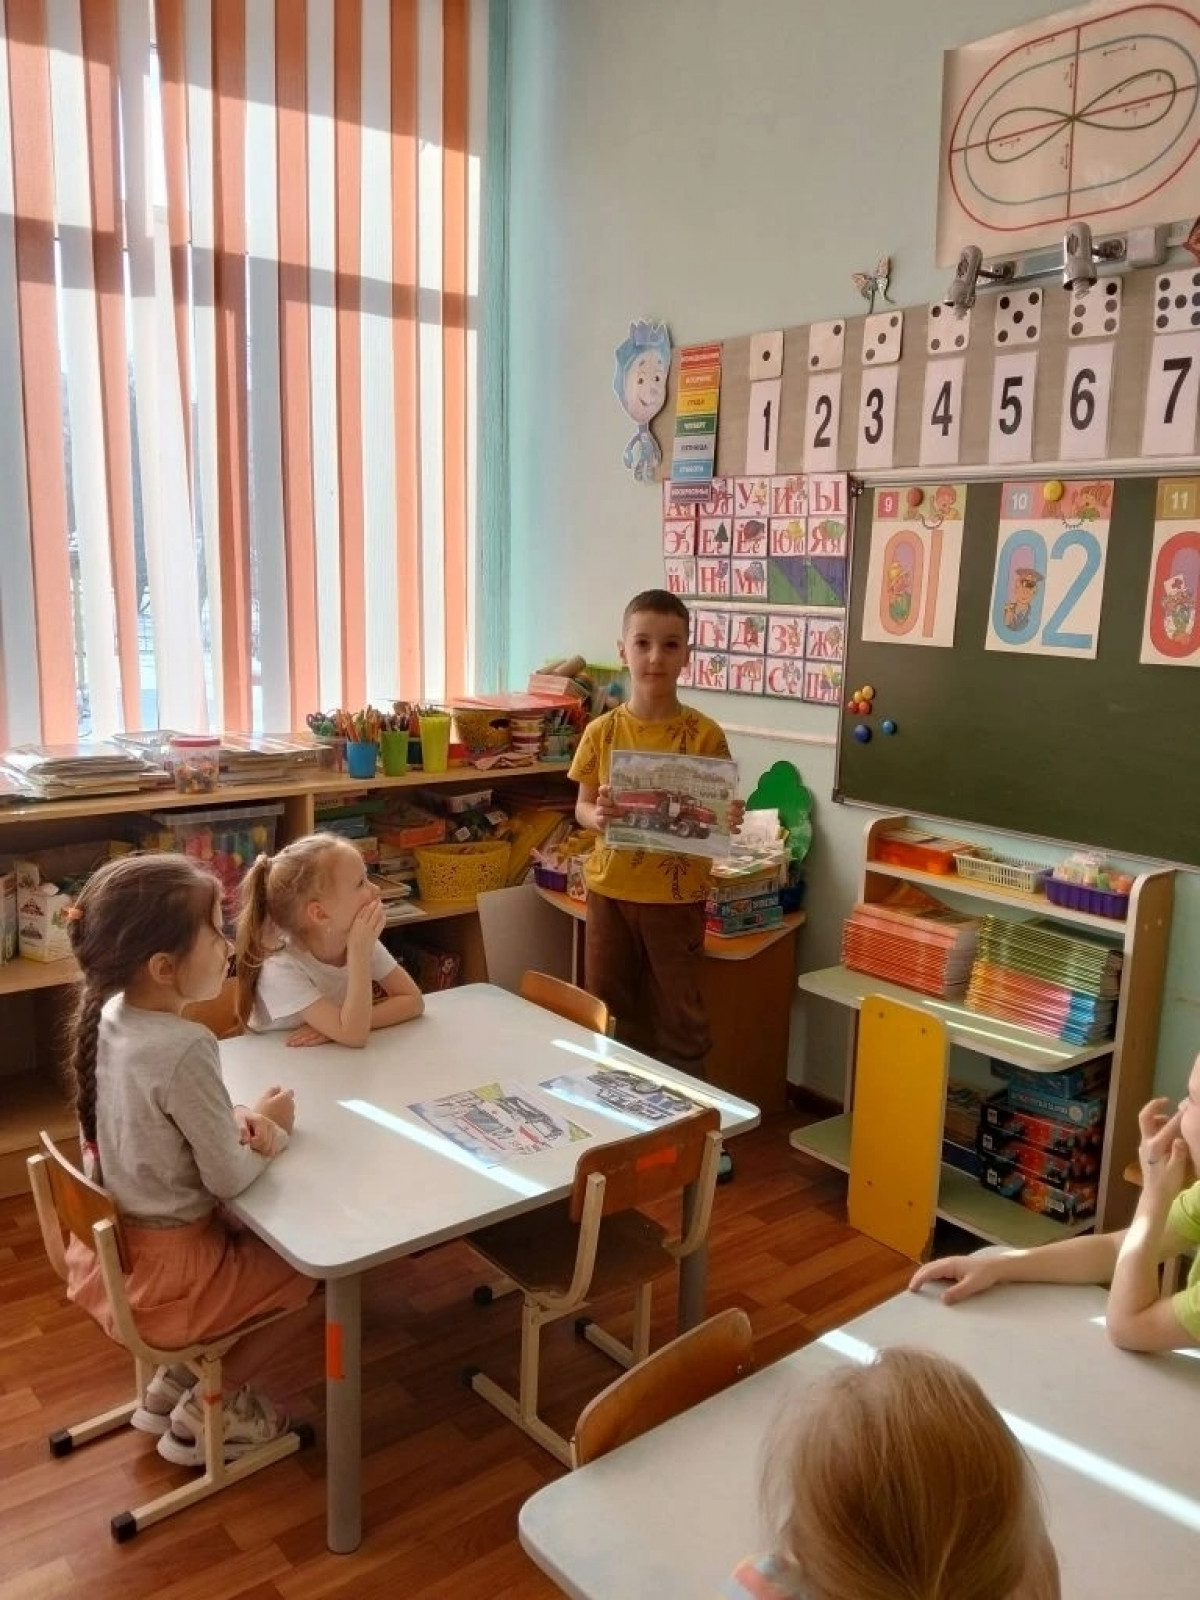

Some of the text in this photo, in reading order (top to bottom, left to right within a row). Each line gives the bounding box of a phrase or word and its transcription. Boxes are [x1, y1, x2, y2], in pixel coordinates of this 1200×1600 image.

[762, 356, 1194, 452] 1 2 3 4 5 6 7
[813, 480, 843, 512] Ы
[884, 496, 893, 511] 9
[1012, 491, 1027, 508] 10
[1170, 491, 1190, 509] 11
[880, 529, 944, 638] 01
[992, 528, 1102, 649] 02
